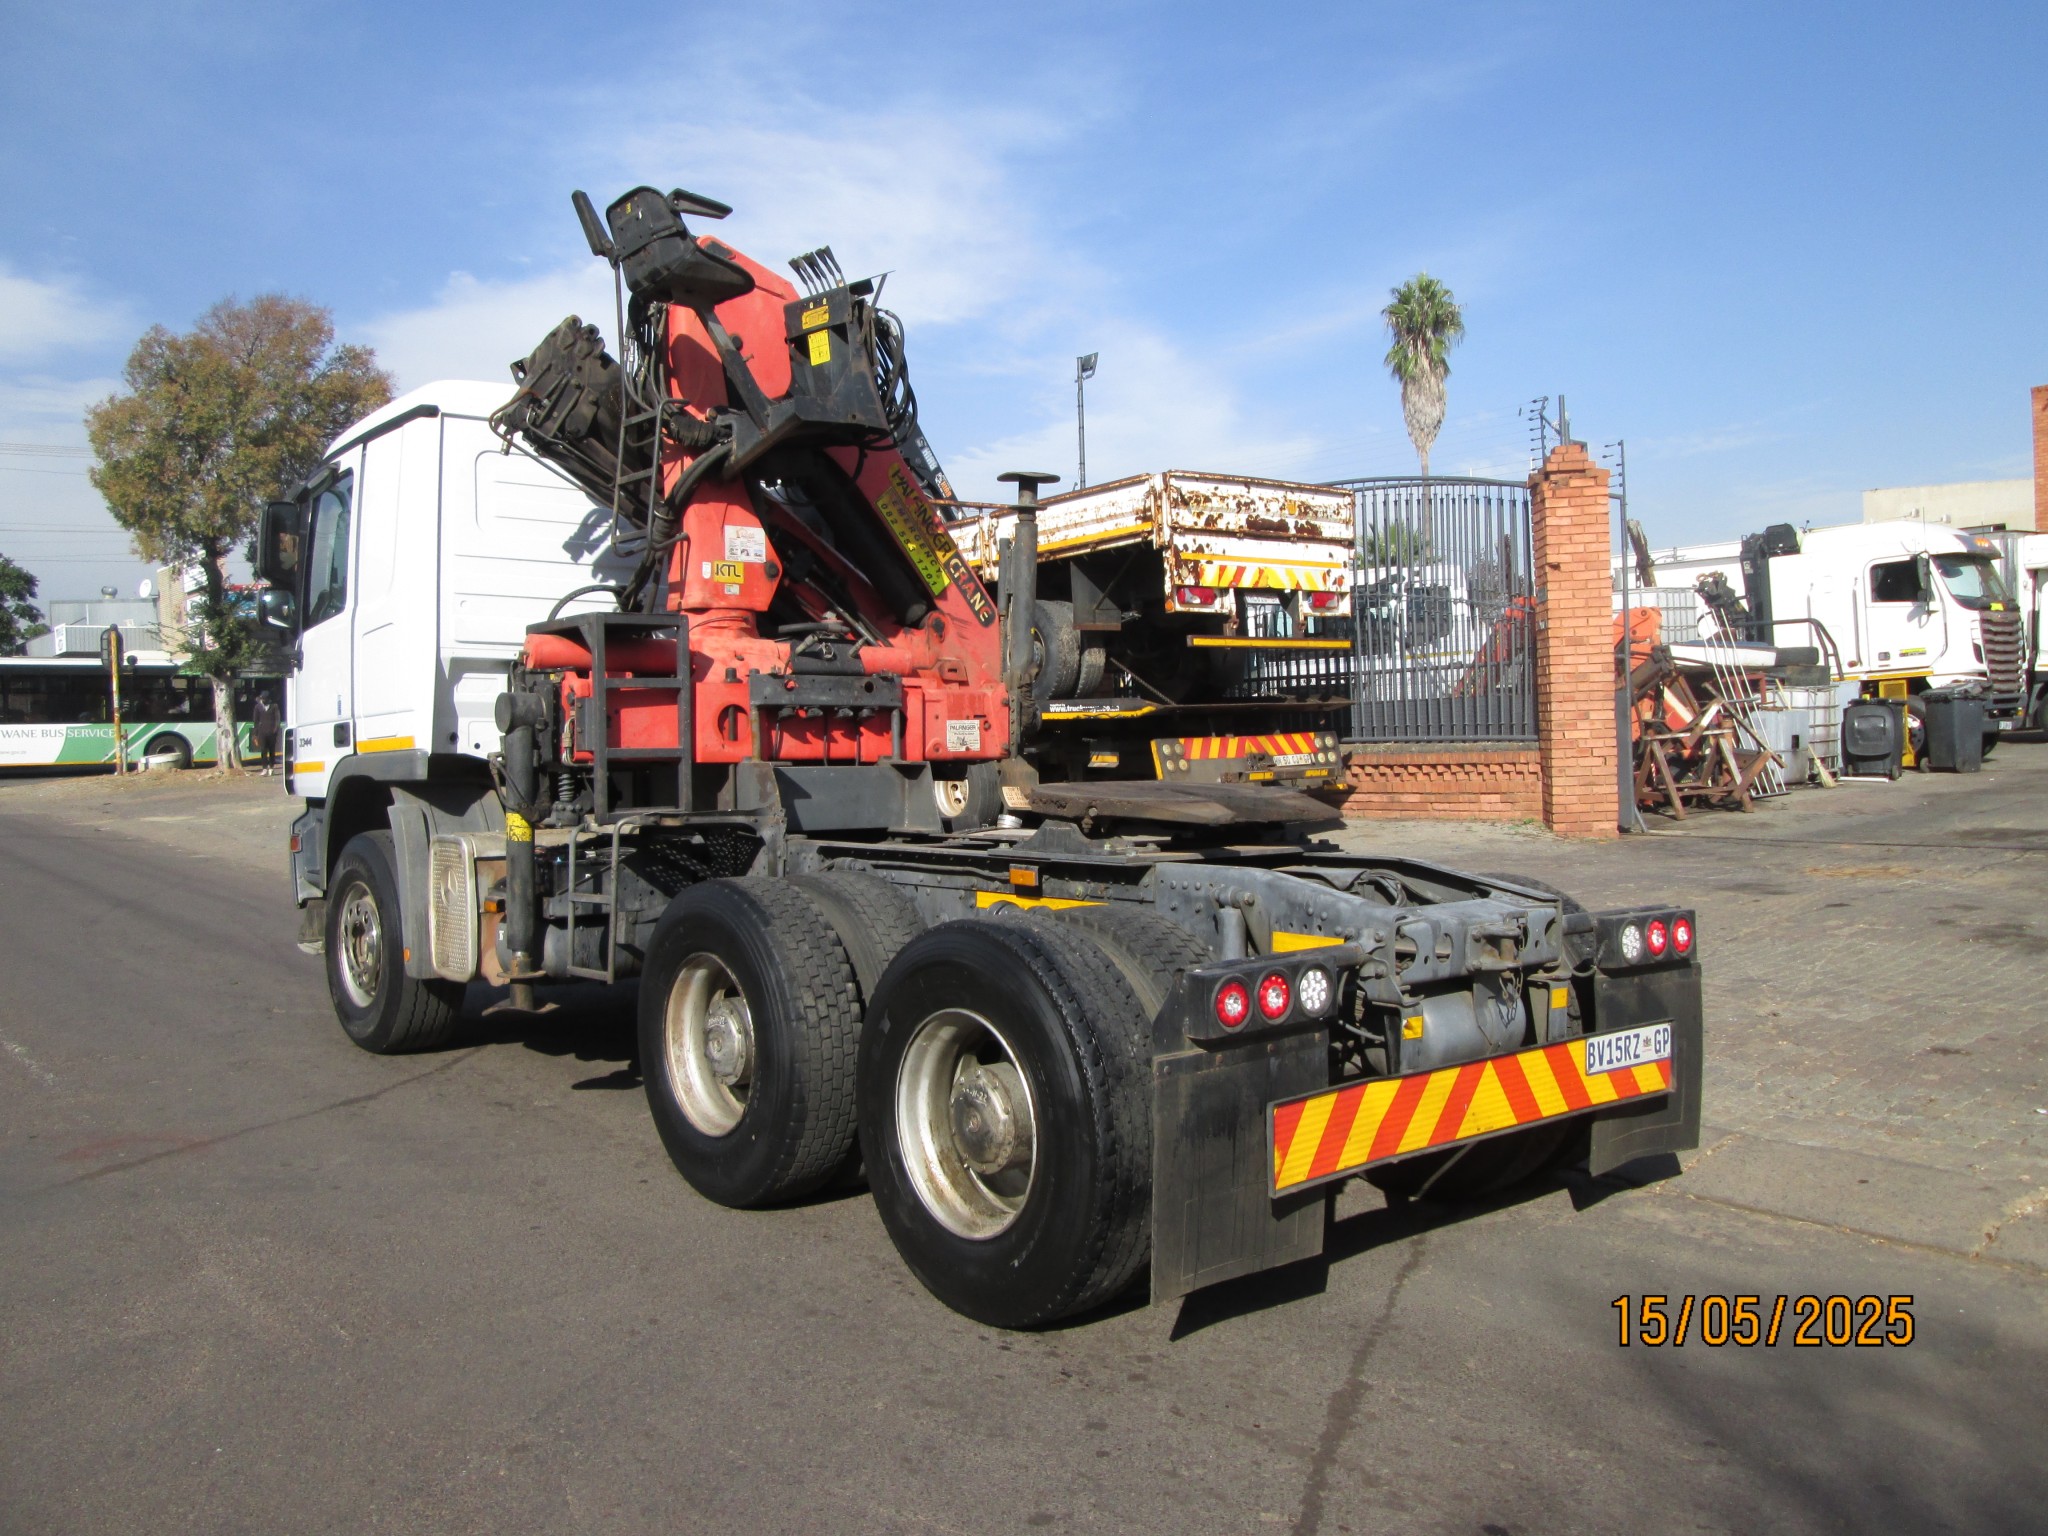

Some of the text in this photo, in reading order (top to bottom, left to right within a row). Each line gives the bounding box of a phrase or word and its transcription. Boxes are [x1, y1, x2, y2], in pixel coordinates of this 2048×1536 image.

[715, 564, 741, 577] KTL
[949, 558, 990, 622] CRANE
[41, 728, 64, 738] BUS
[67, 728, 116, 738] SERVICE
[1588, 1027, 1669, 1069] BV15RZ GP
